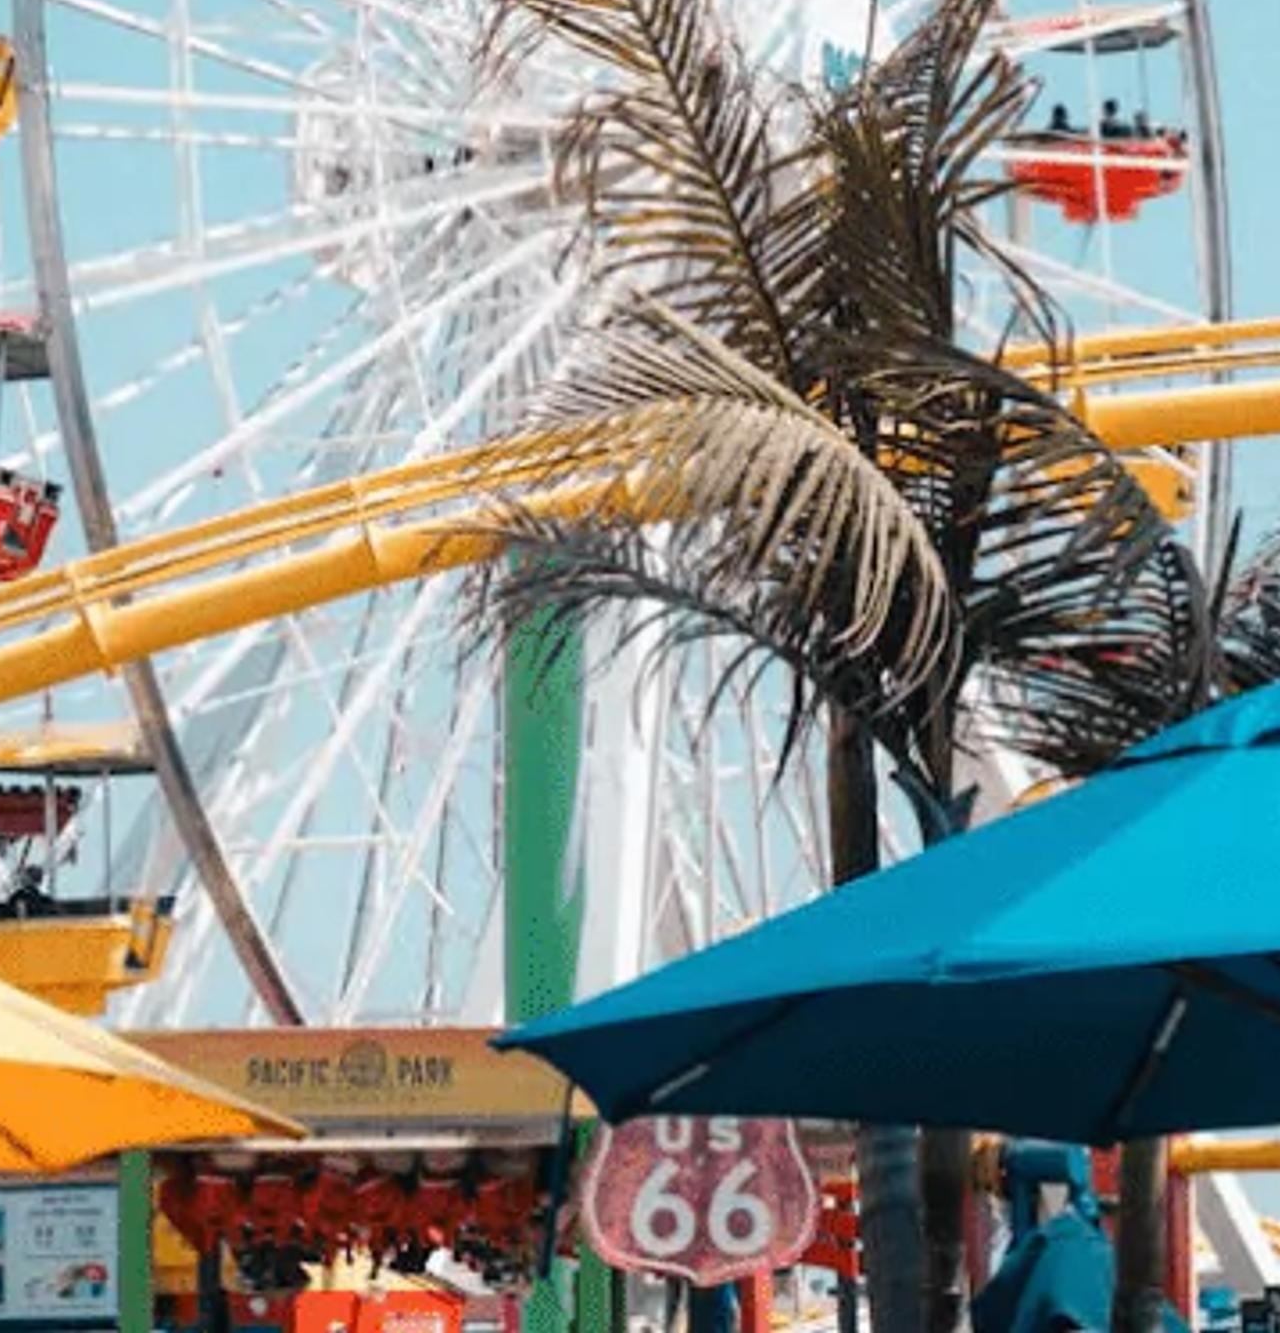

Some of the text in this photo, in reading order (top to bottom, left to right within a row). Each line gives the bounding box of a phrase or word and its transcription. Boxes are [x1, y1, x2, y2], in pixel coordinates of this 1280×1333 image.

[247, 1054, 455, 1086] PACIFIC PARK
[630, 1156, 774, 1256] 66
